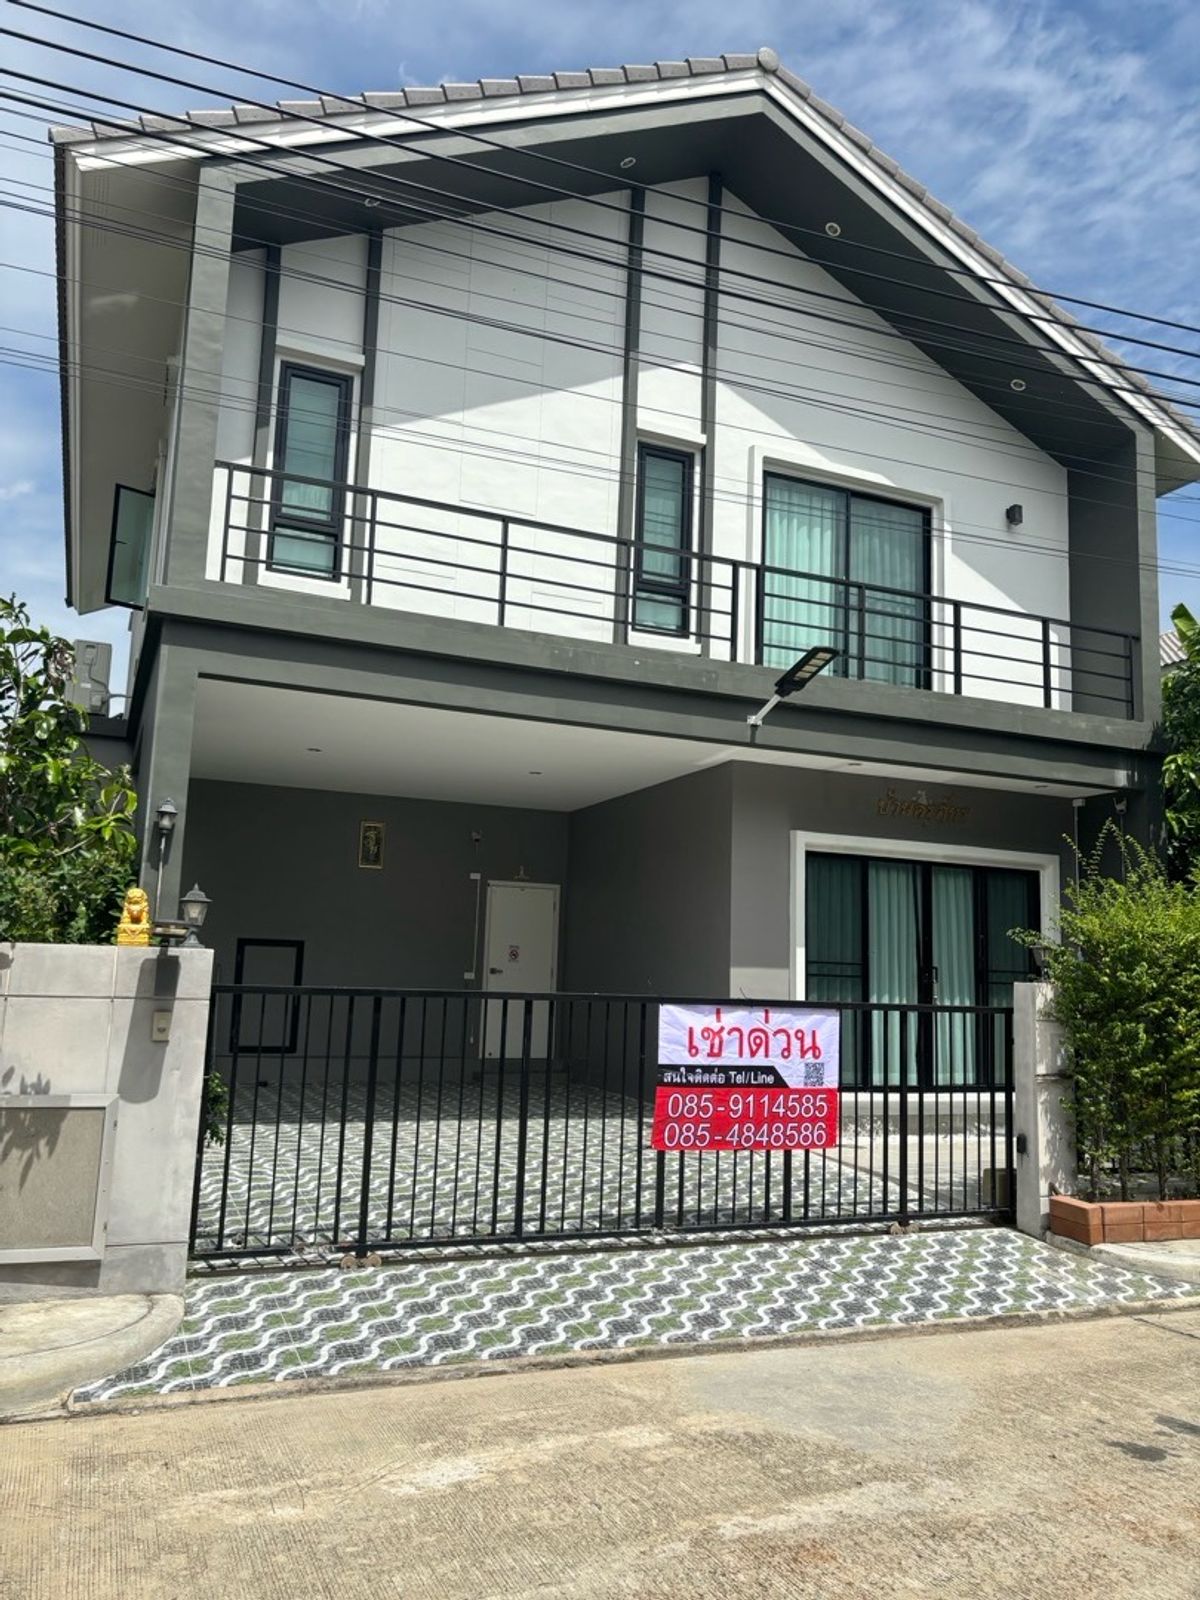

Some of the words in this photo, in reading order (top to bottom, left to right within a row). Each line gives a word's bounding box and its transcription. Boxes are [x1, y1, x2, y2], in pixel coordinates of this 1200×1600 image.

[687, 1007, 822, 1060] เช่าด่วน
[663, 1066, 726, 1084] สนใจติดต่อ
[728, 1071, 775, 1084] Tel/Line
[667, 1093, 828, 1118] 085-9114585
[663, 1122, 827, 1147] 085-4848586
